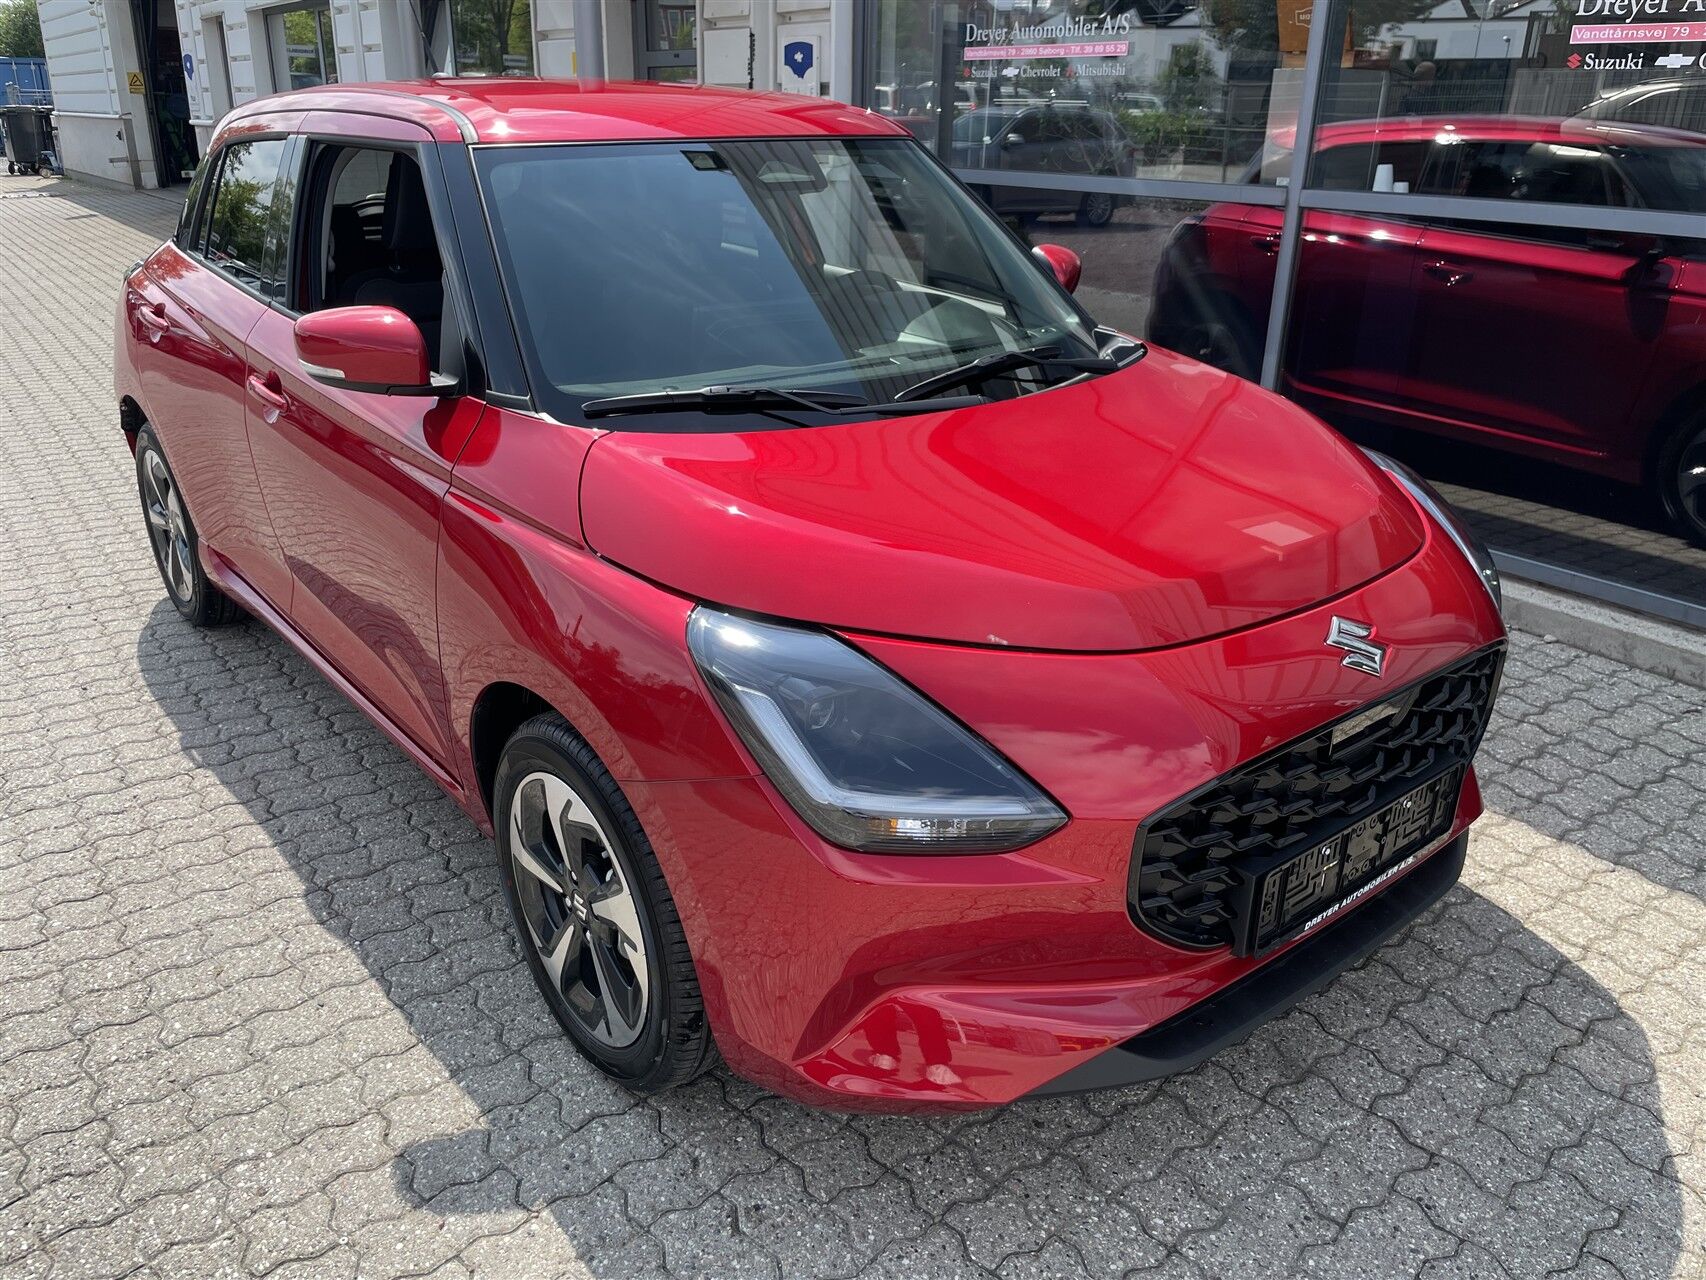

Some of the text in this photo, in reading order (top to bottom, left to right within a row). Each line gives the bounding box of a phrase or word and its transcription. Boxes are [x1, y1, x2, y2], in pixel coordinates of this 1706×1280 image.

[1575, 0, 1669, 23] Dreyer
[965, 13, 1131, 47] Dreyer Automobiler A/S
[1575, 26, 1668, 40] Vandtårnsvej
[1672, 26, 1690, 37] 79
[971, 63, 1126, 78] Suzuki Chevrolet Mitsubishi
[1583, 52, 1644, 70] Suzuki
[1304, 903, 1340, 931] DREYER
[1340, 865, 1398, 908] AUTOMOBILER
